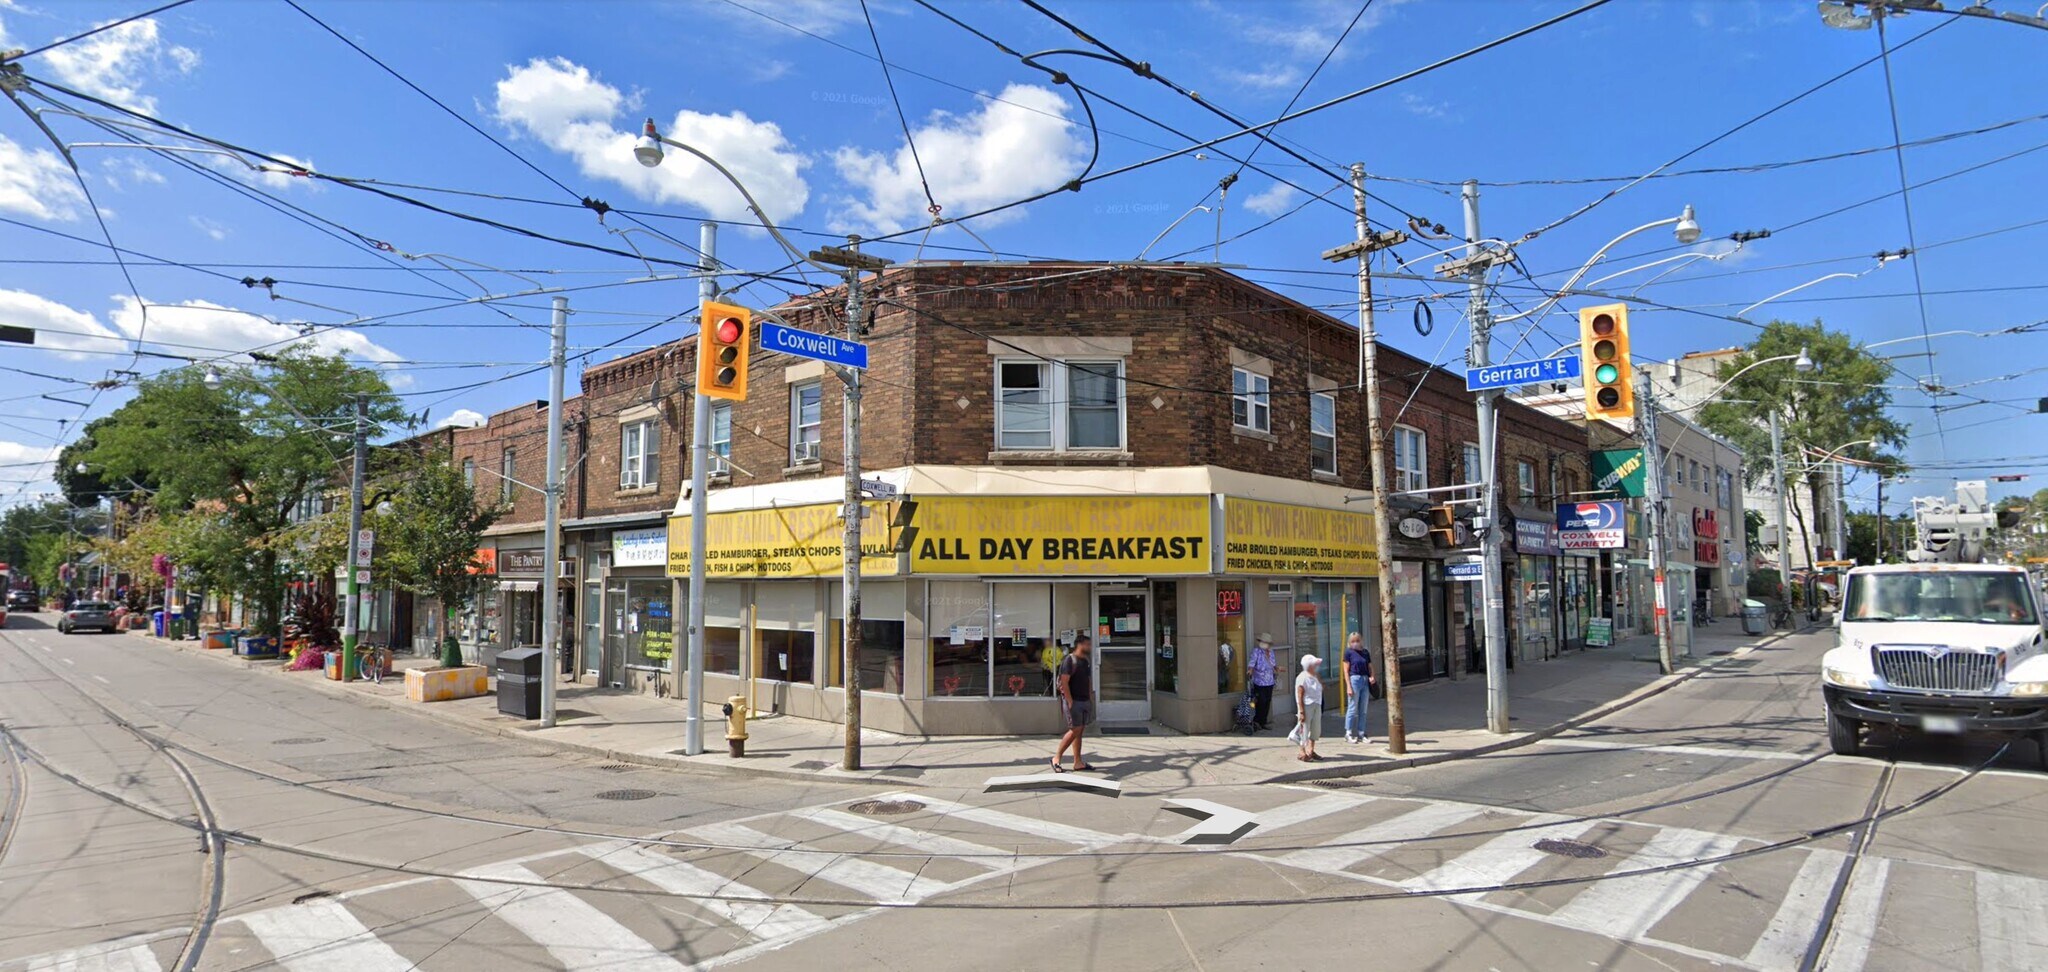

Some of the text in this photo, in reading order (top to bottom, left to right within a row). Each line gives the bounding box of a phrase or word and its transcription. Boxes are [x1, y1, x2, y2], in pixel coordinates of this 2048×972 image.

[777, 328, 855, 357] Coxwell Ave
[1479, 359, 1567, 385] Gerrard St E
[1597, 452, 1642, 491] SUBWAY
[862, 481, 887, 493] COXWELL
[1227, 500, 1254, 535] NEW
[1257, 504, 1289, 538] TOWN
[1292, 508, 1328, 541] FAMILY
[1565, 519, 1601, 528] PEPSI
[1516, 521, 1546, 535] COXWELL
[1518, 535, 1545, 548] VARIETY
[1561, 531, 1621, 540] COXWELL
[919, 536, 1203, 560] ALL DAY BREAKFAST
[1227, 542, 1248, 554] CHAR
[1249, 544, 1279, 556] BROILED
[1279, 546, 1320, 559] HAMBURGER,
[1320, 548, 1343, 559] STEAKS
[1343, 549, 1361, 560] CHOPS
[1565, 540, 1617, 548] VARIETY
[670, 551, 689, 561] CHAR
[720, 548, 770, 560] HAMBURGER,
[773, 546, 807, 558] STEAKS
[808, 545, 842, 557] CHOPS
[510, 555, 522, 567] THE
[523, 554, 544, 567] PANTRY
[669, 563, 686, 573] FRIED
[714, 563, 728, 573] FISH
[729, 563, 734, 572] &
[735, 562, 757, 573] CHIPS,
[757, 562, 792, 573] HOTDOGS
[1227, 557, 1246, 569] FRIED
[1246, 558, 1274, 571] CHICKEN,
[1274, 560, 1287, 570] FISH
[1292, 560, 1310, 572] CHIPS,
[1310, 561, 1334, 572] HOTDOGS
[1448, 566, 1471, 575] Gerrard
[1217, 590, 1241, 611] OPEN
